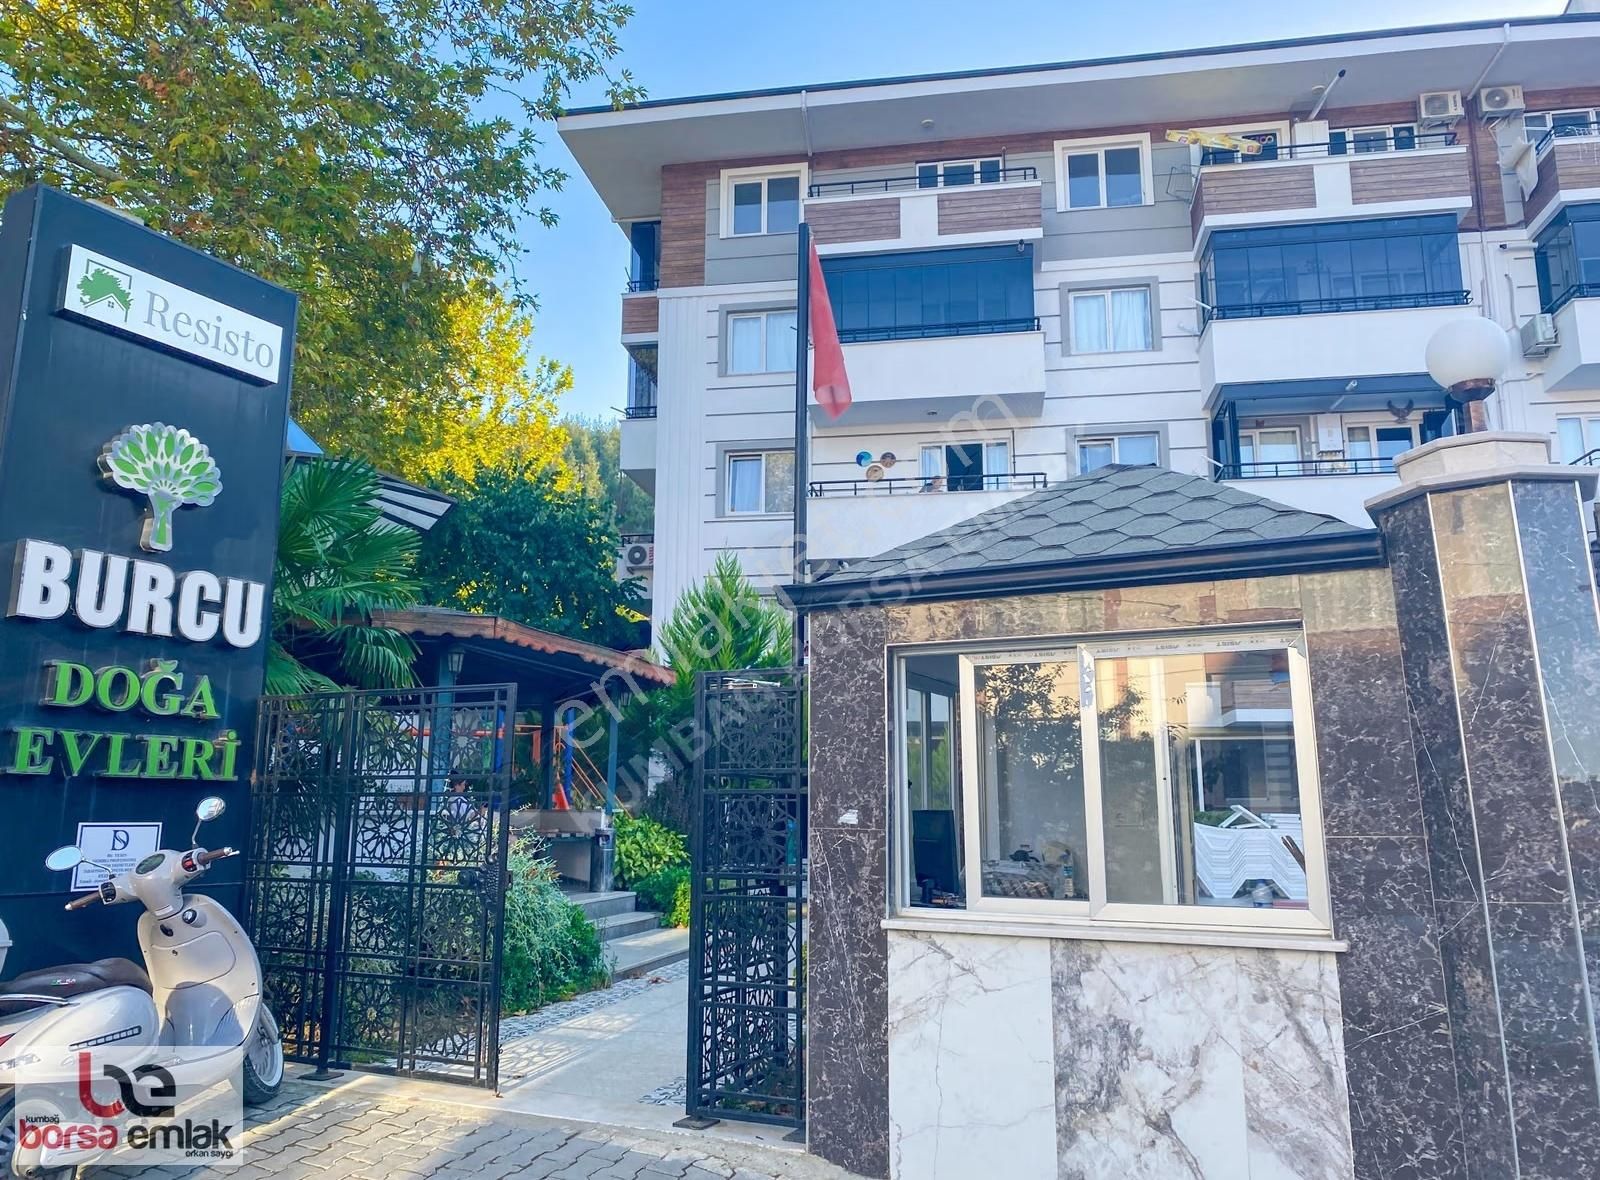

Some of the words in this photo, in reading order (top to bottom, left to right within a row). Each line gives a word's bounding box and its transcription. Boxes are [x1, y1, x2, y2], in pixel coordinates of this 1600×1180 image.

[143, 290, 274, 368] Resisto
[7, 538, 265, 648] BURCU
[42, 658, 220, 719] DOĞA
[2, 727, 241, 781] EVLERİ
